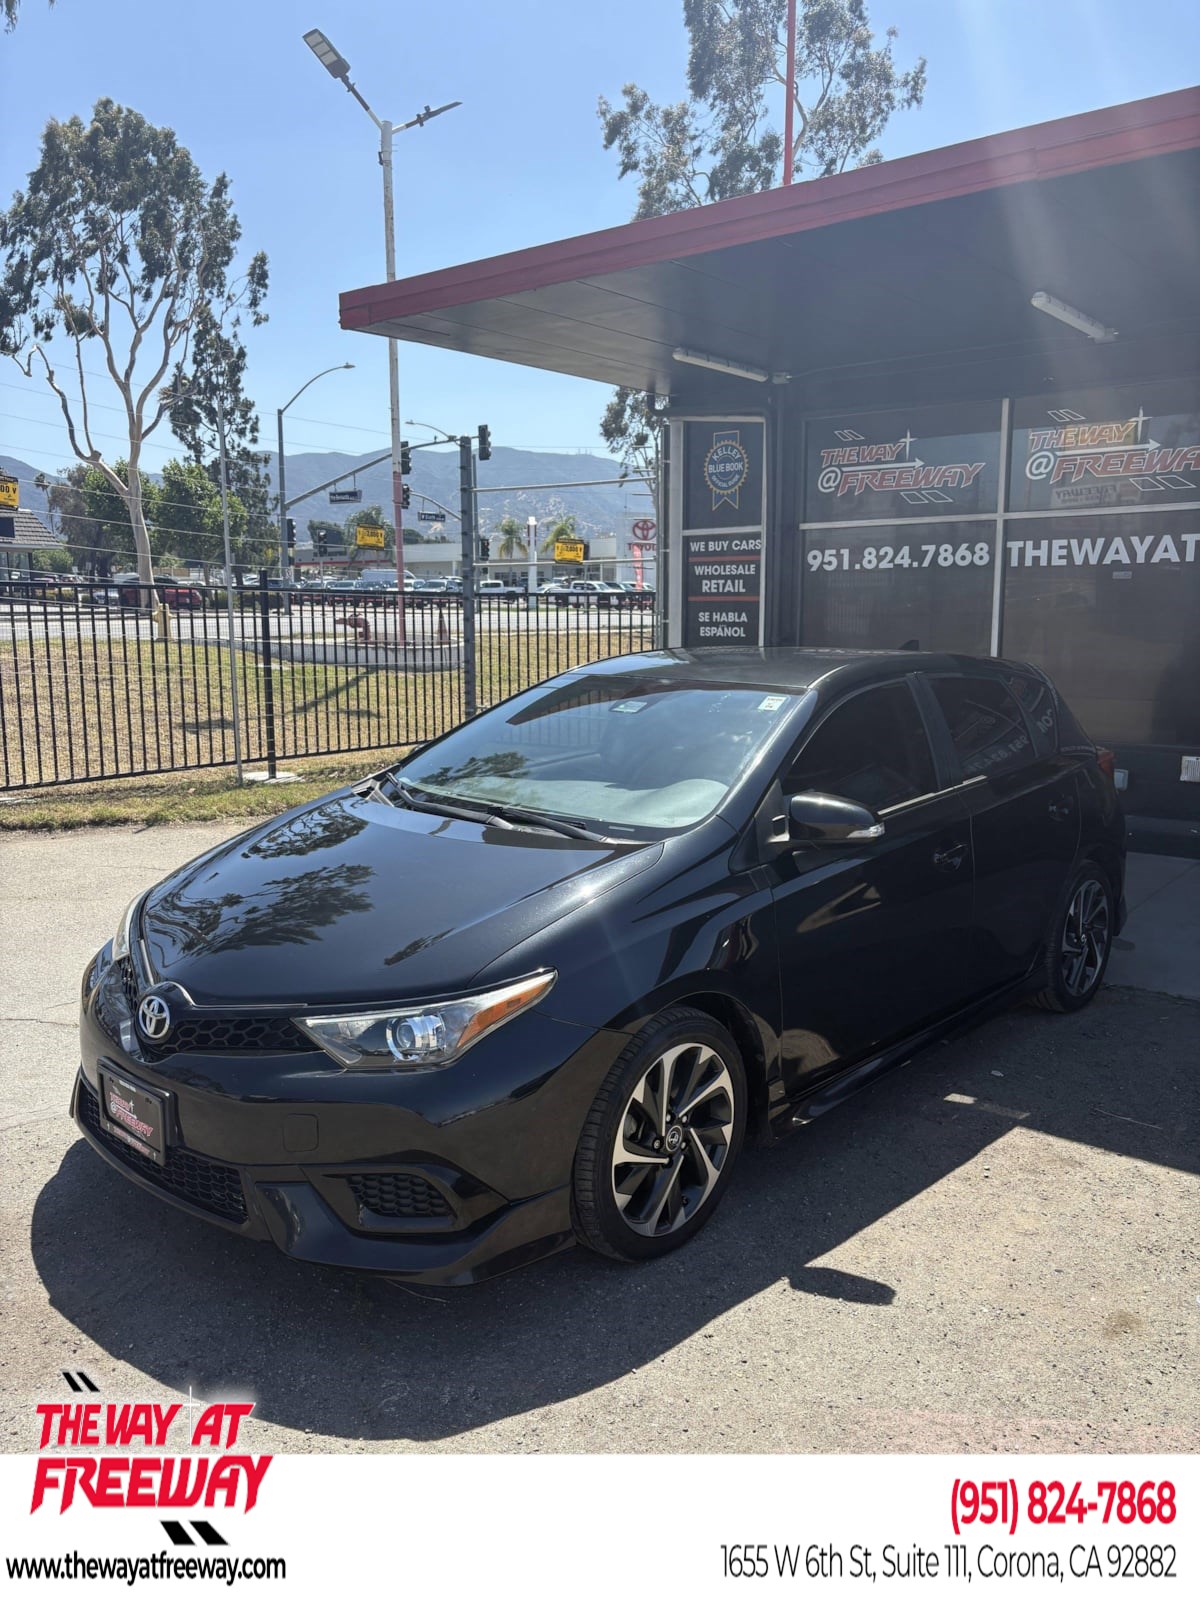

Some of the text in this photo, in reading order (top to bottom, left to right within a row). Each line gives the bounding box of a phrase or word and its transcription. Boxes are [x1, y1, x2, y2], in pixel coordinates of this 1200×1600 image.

[712, 446, 741, 462] KELLEY
[708, 462, 744, 474] BLUE BOOK
[690, 539, 762, 552] WE BUY CARS
[807, 542, 990, 572] 951.824.7868
[694, 564, 756, 575] WHOLESALE
[702, 579, 746, 593] RETAIL
[698, 612, 748, 622] SE HABLA
[700, 624, 746, 637] ESPAÑOL
